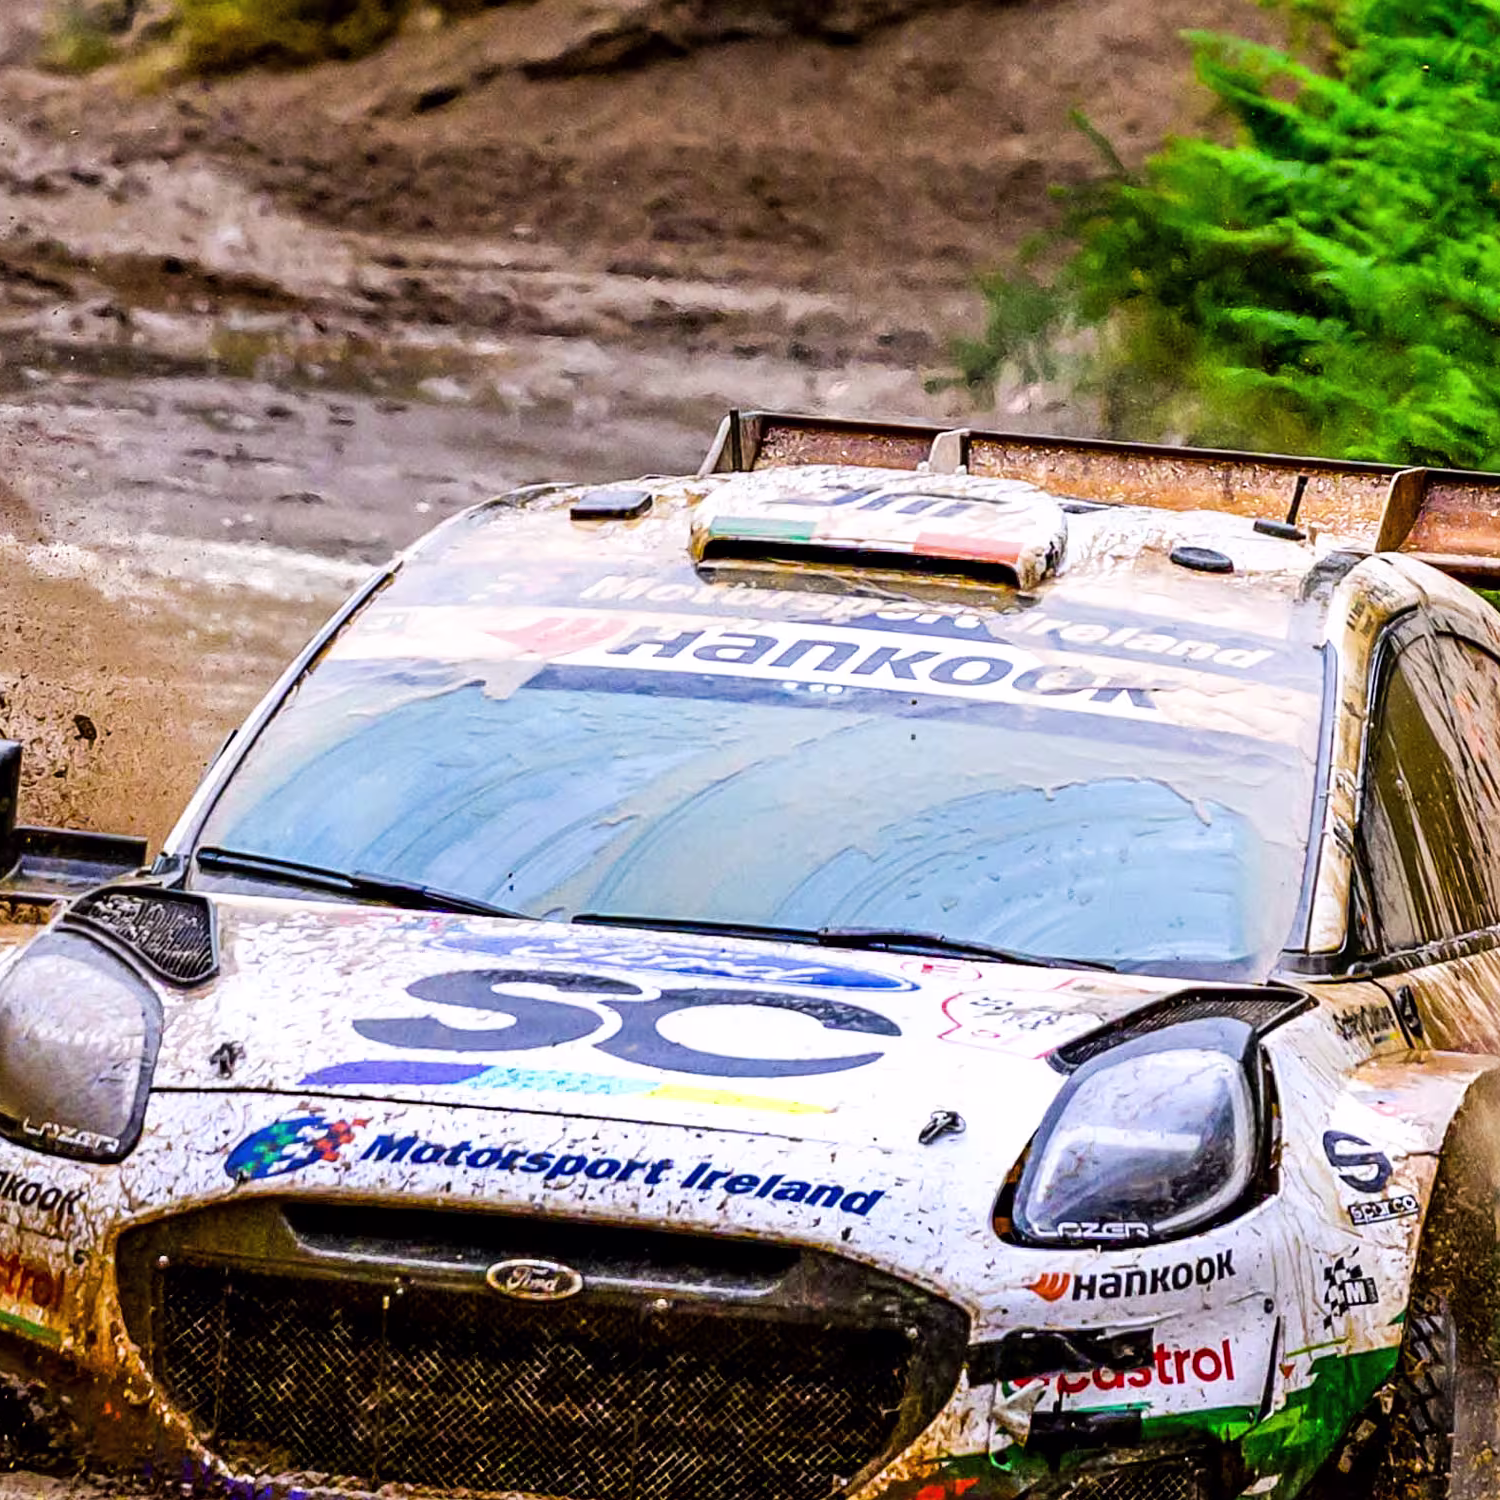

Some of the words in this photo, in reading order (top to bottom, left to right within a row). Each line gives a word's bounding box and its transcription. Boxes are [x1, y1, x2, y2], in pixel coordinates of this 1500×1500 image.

[359, 1133, 675, 1185] Motorsport
[681, 1161, 887, 1217] Ireland
[1071, 1248, 1237, 1301] Hankook
